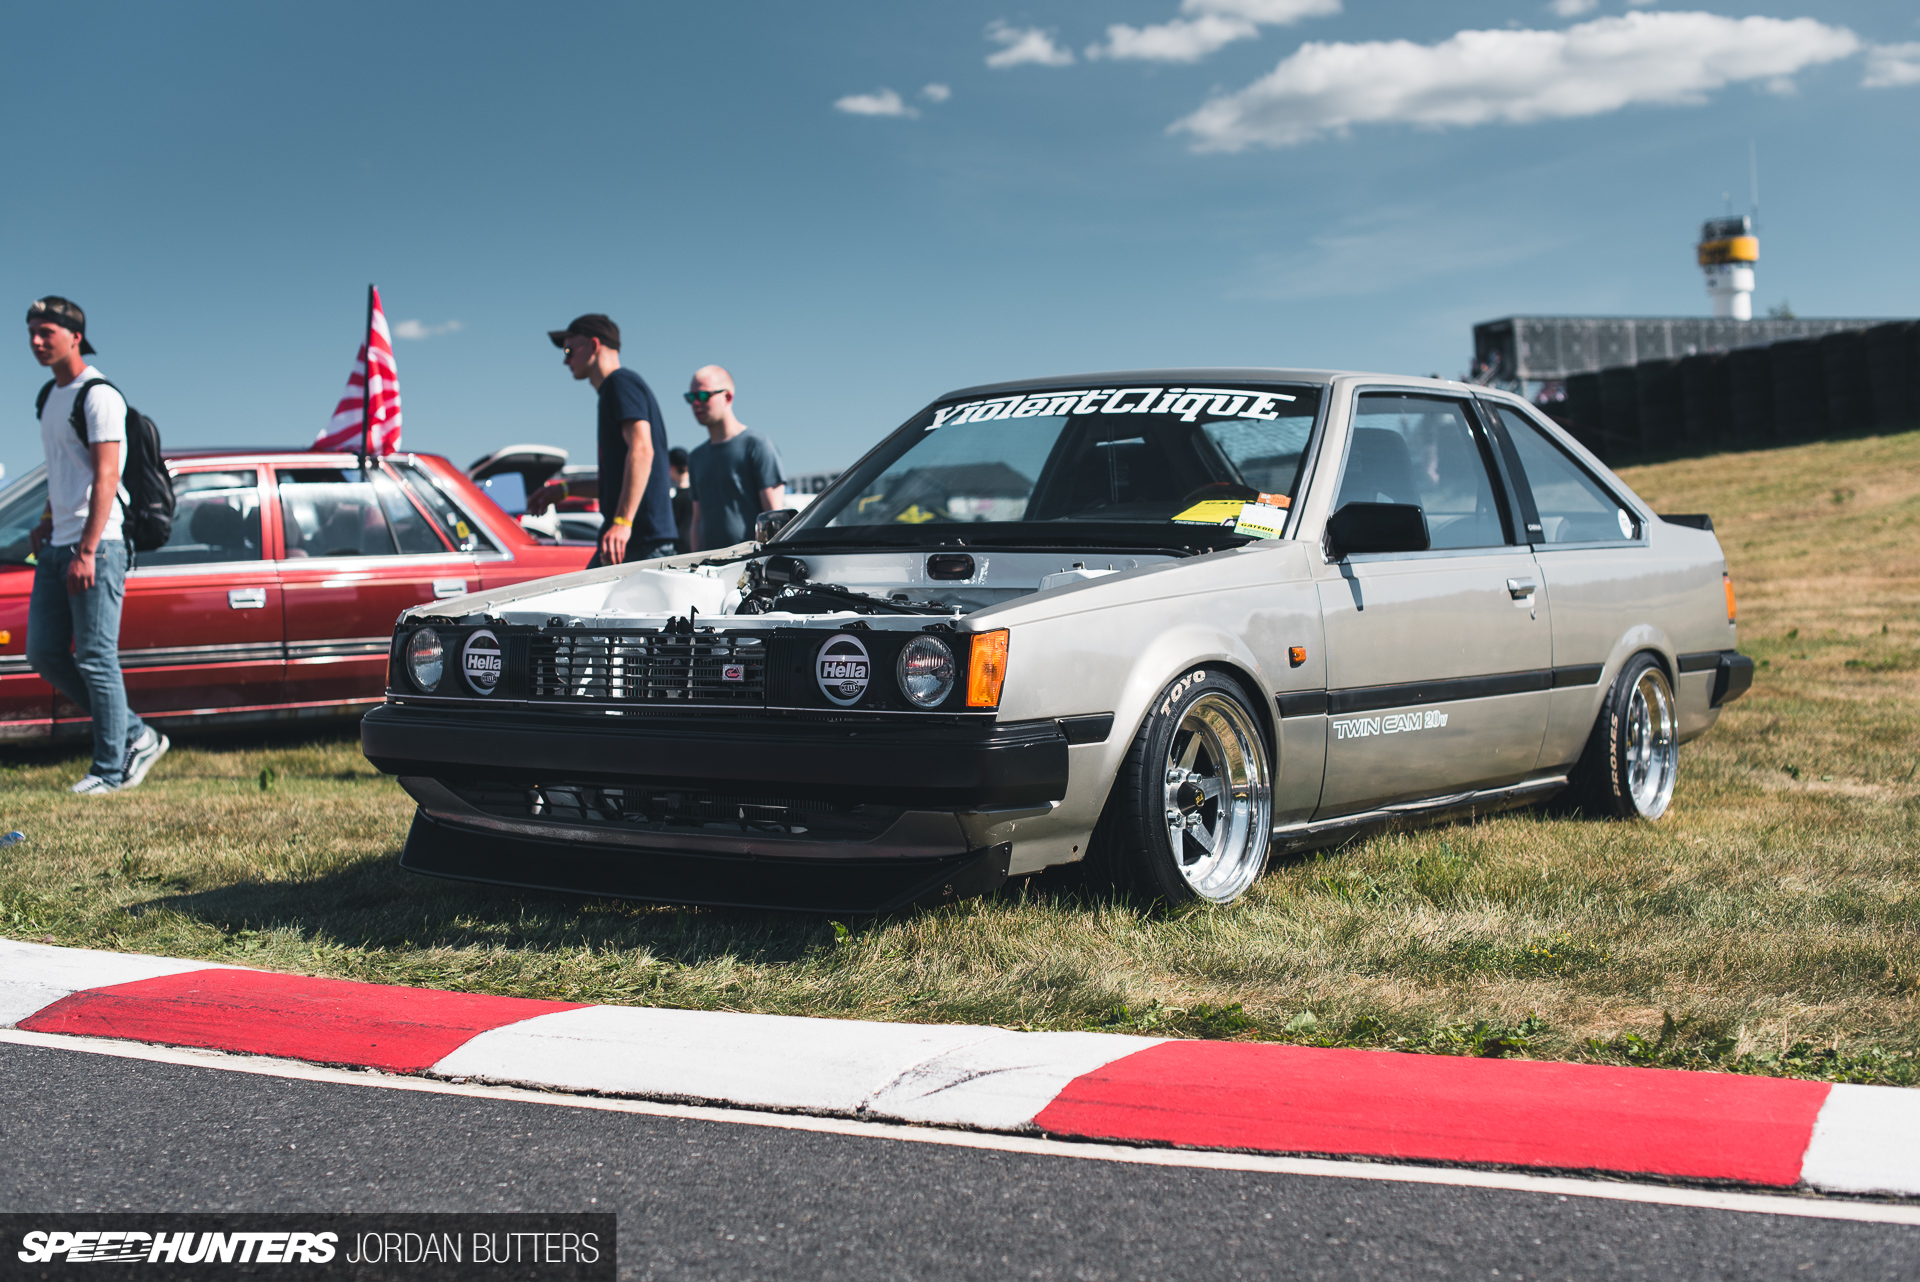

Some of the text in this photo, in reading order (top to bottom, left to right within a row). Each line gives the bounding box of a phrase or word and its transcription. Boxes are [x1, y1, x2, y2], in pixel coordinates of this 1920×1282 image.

[467, 654, 502, 670] Hella
[822, 662, 867, 678] Hella
[1160, 670, 1206, 717] TOYO
[1332, 716, 1380, 740] TWIN
[1382, 712, 1423, 734] CAM
[1609, 712, 1622, 797] PROXES
